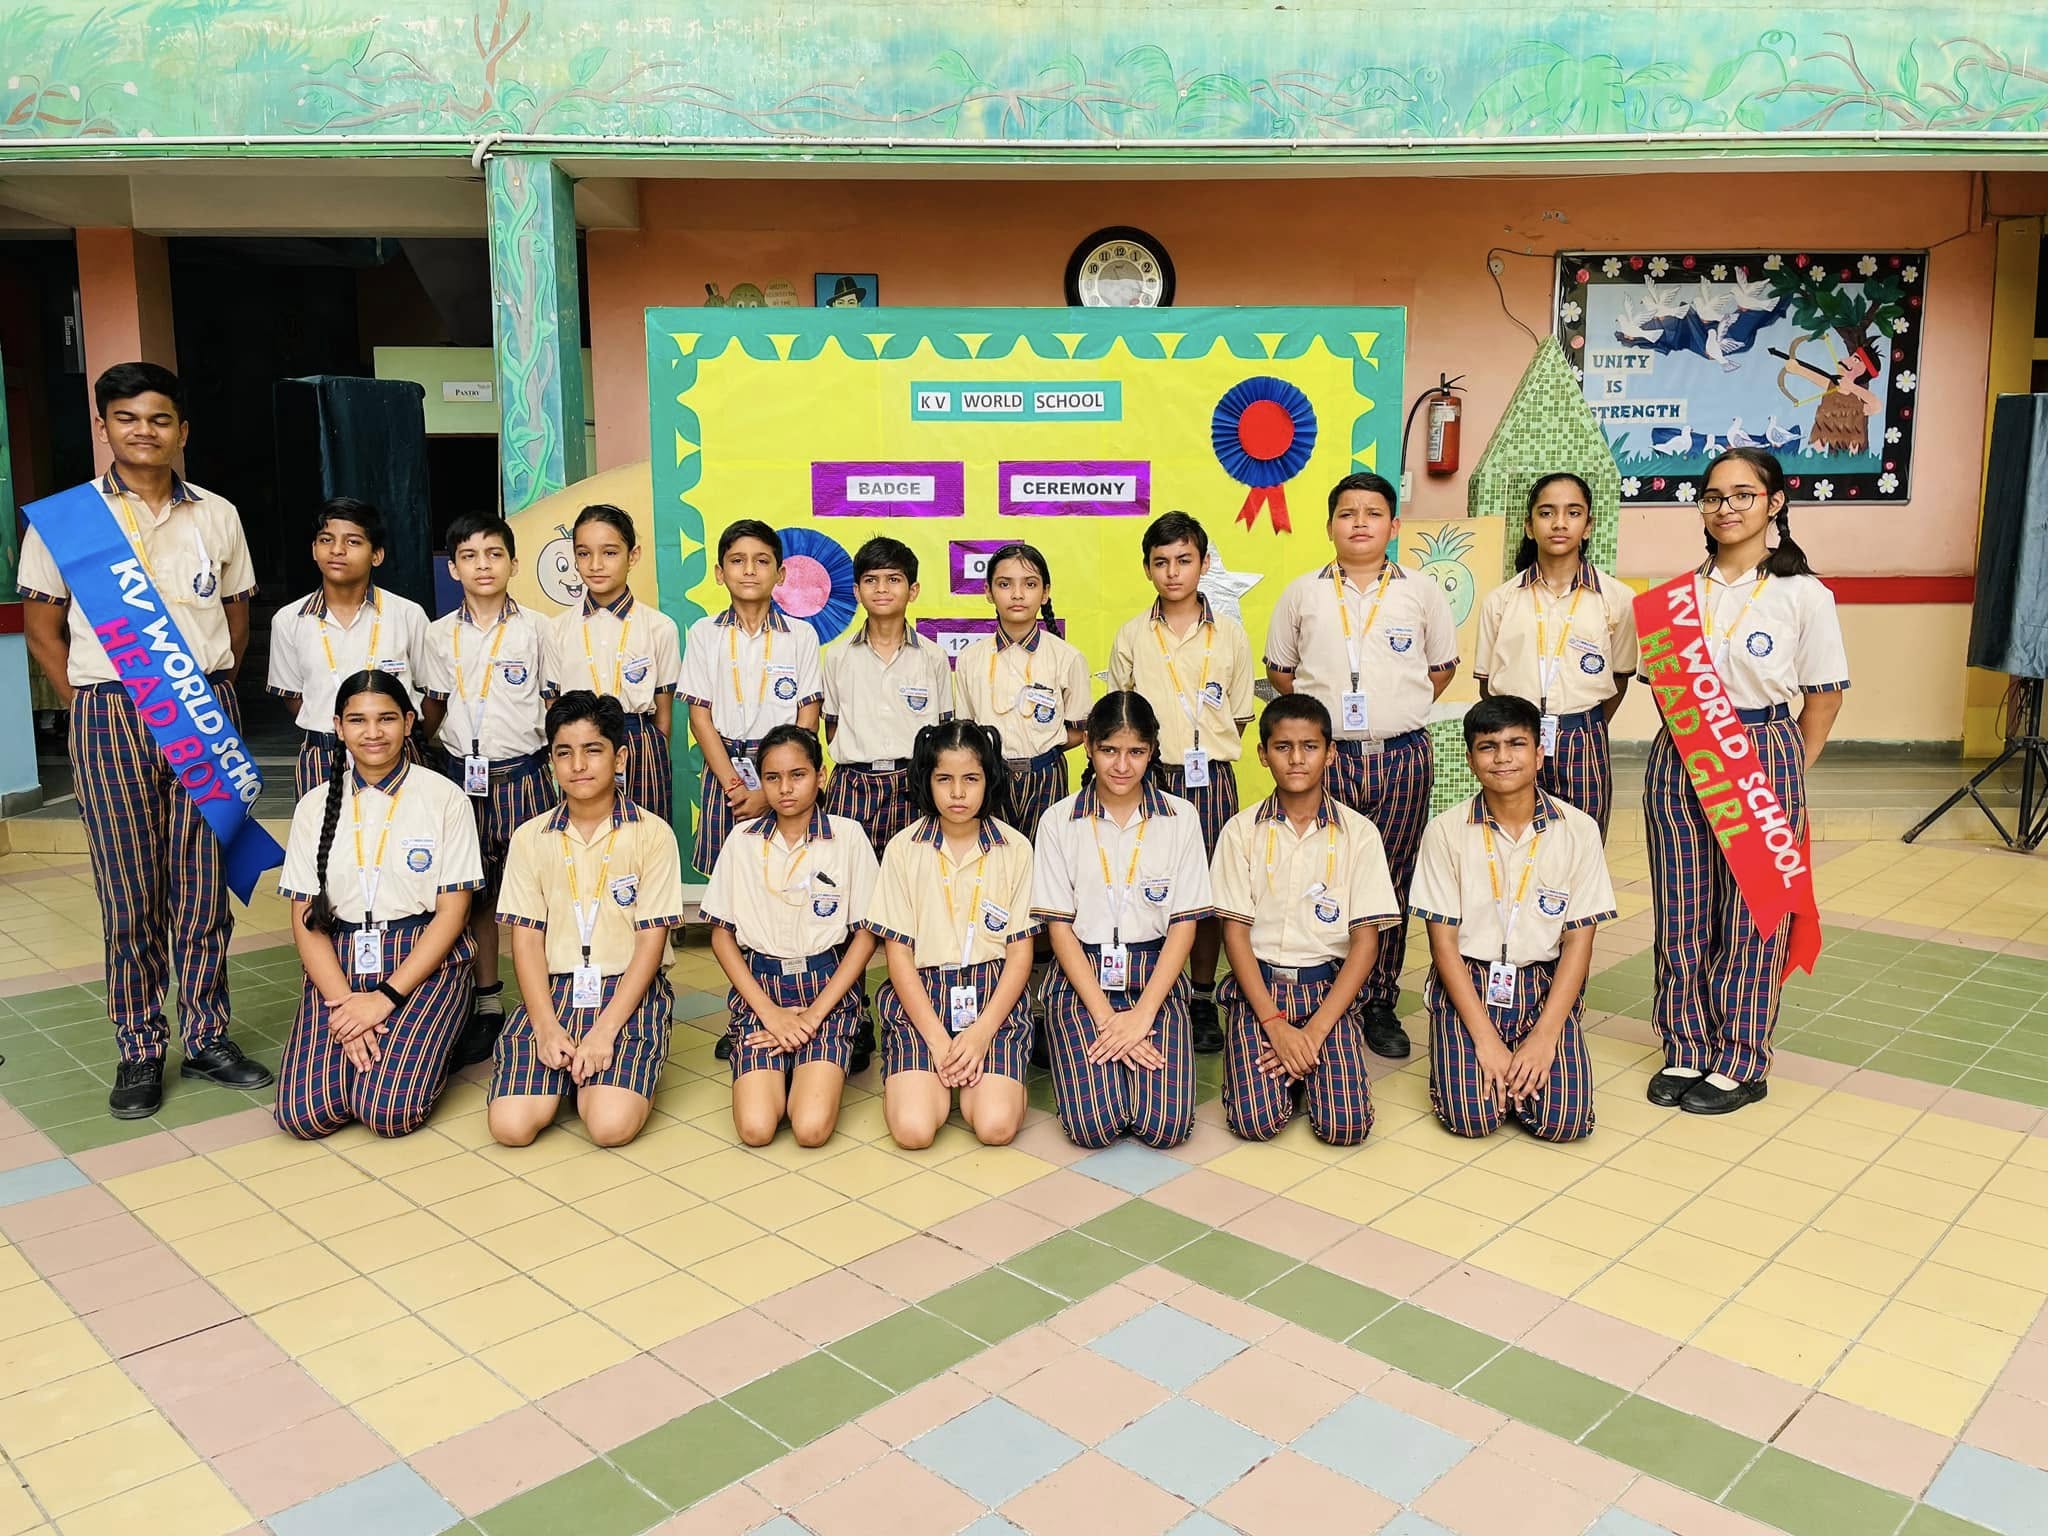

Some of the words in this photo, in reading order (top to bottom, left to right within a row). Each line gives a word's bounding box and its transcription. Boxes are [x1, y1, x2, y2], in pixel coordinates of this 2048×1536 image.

[1101, 251, 1109, 260] 11
[1115, 247, 1125, 257] 12
[1090, 264, 1098, 274] 10
[1144, 262, 1151, 273] 2
[1592, 354, 1650, 369] UNITY
[1606, 380, 1622, 393] IS
[963, 394, 1022, 408] WORLD
[1036, 393, 1103, 409] SCHOOL
[858, 482, 921, 495] BADGE
[1022, 481, 1126, 495] CEREMONY
[973, 560, 986, 573] O
[1667, 583, 1700, 627] KV
[950, 638, 969, 650] 12
[109, 557, 155, 613] KV
[142, 615, 224, 736] WORLD
[211, 736, 263, 819] SCHO
[1679, 635, 1749, 760] WORLD
[94, 616, 178, 728] HEAD
[163, 735, 232, 806] BOY
[1639, 627, 1700, 736] HEAD
[1685, 750, 1749, 848] GIRL
[1737, 771, 1807, 888] SCHOOL
